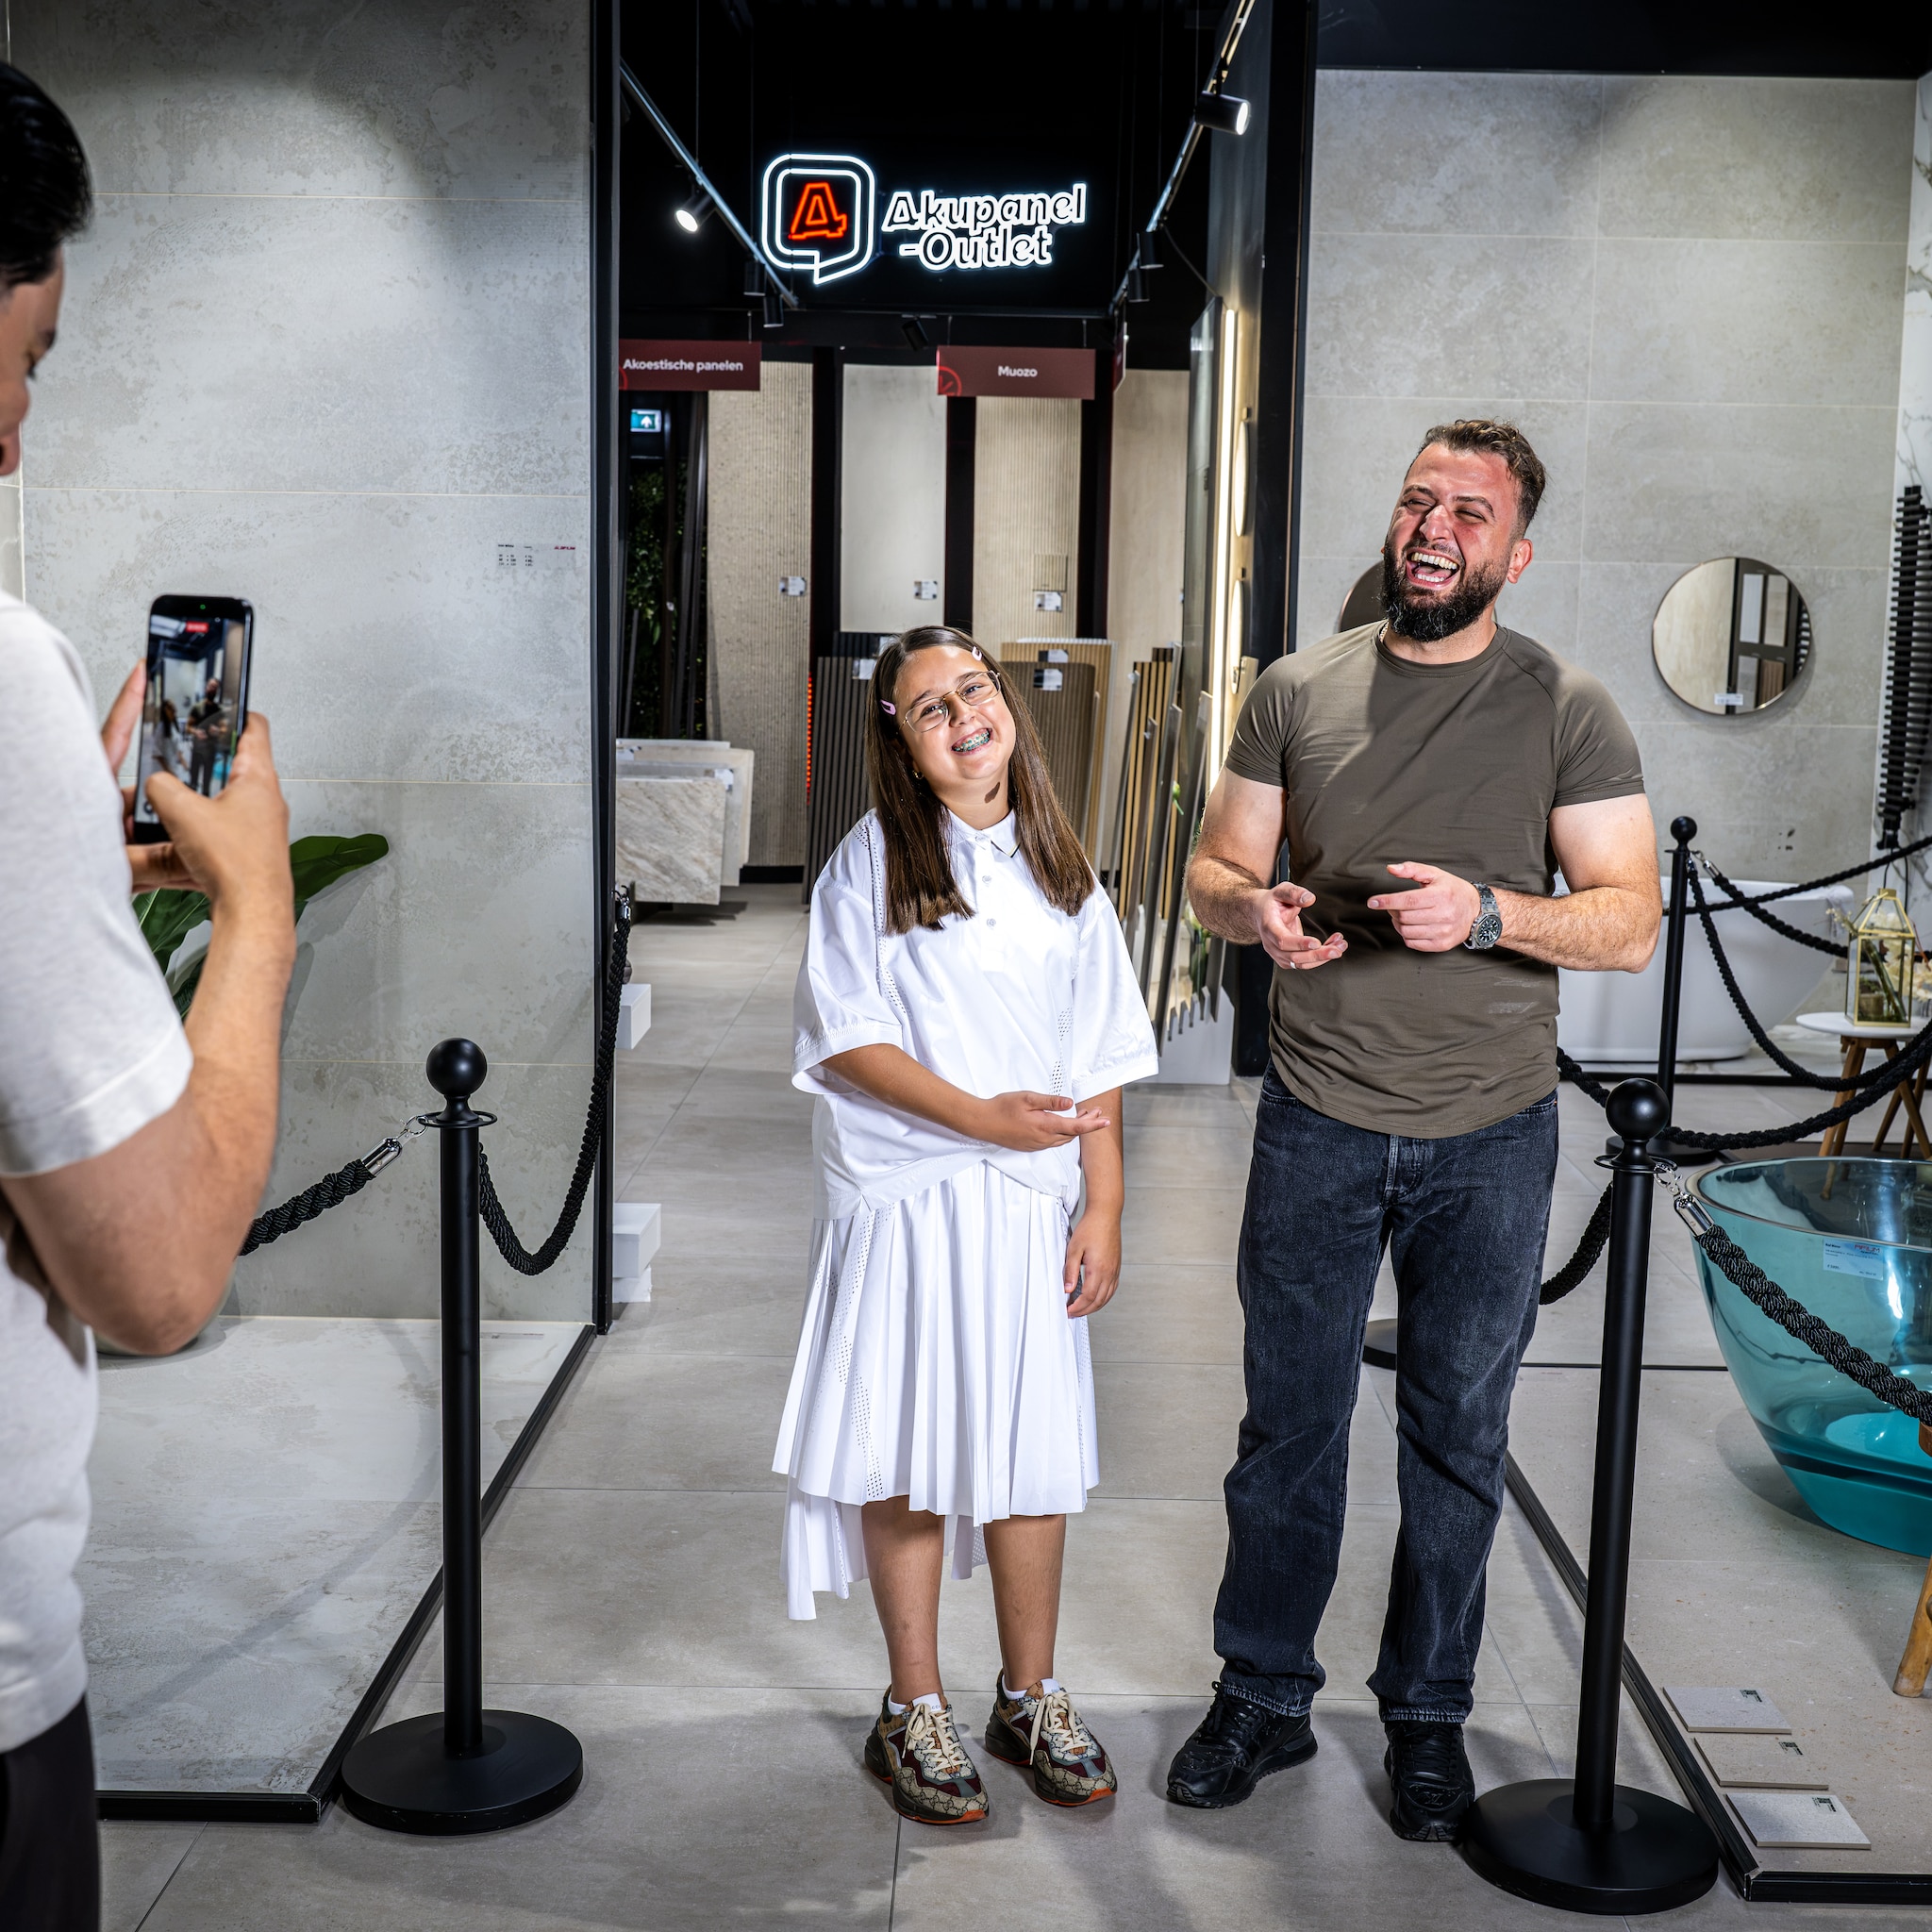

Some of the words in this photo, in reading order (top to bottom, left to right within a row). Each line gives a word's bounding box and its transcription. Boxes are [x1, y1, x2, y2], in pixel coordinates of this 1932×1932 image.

[789, 182, 847, 240] A
[881, 183, 1087, 236] Akupanel
[899, 225, 1053, 271] -Outlet
[623, 358, 695, 371] Akoestische
[696, 359, 743, 374] panelen
[998, 365, 1038, 377] Muozo
